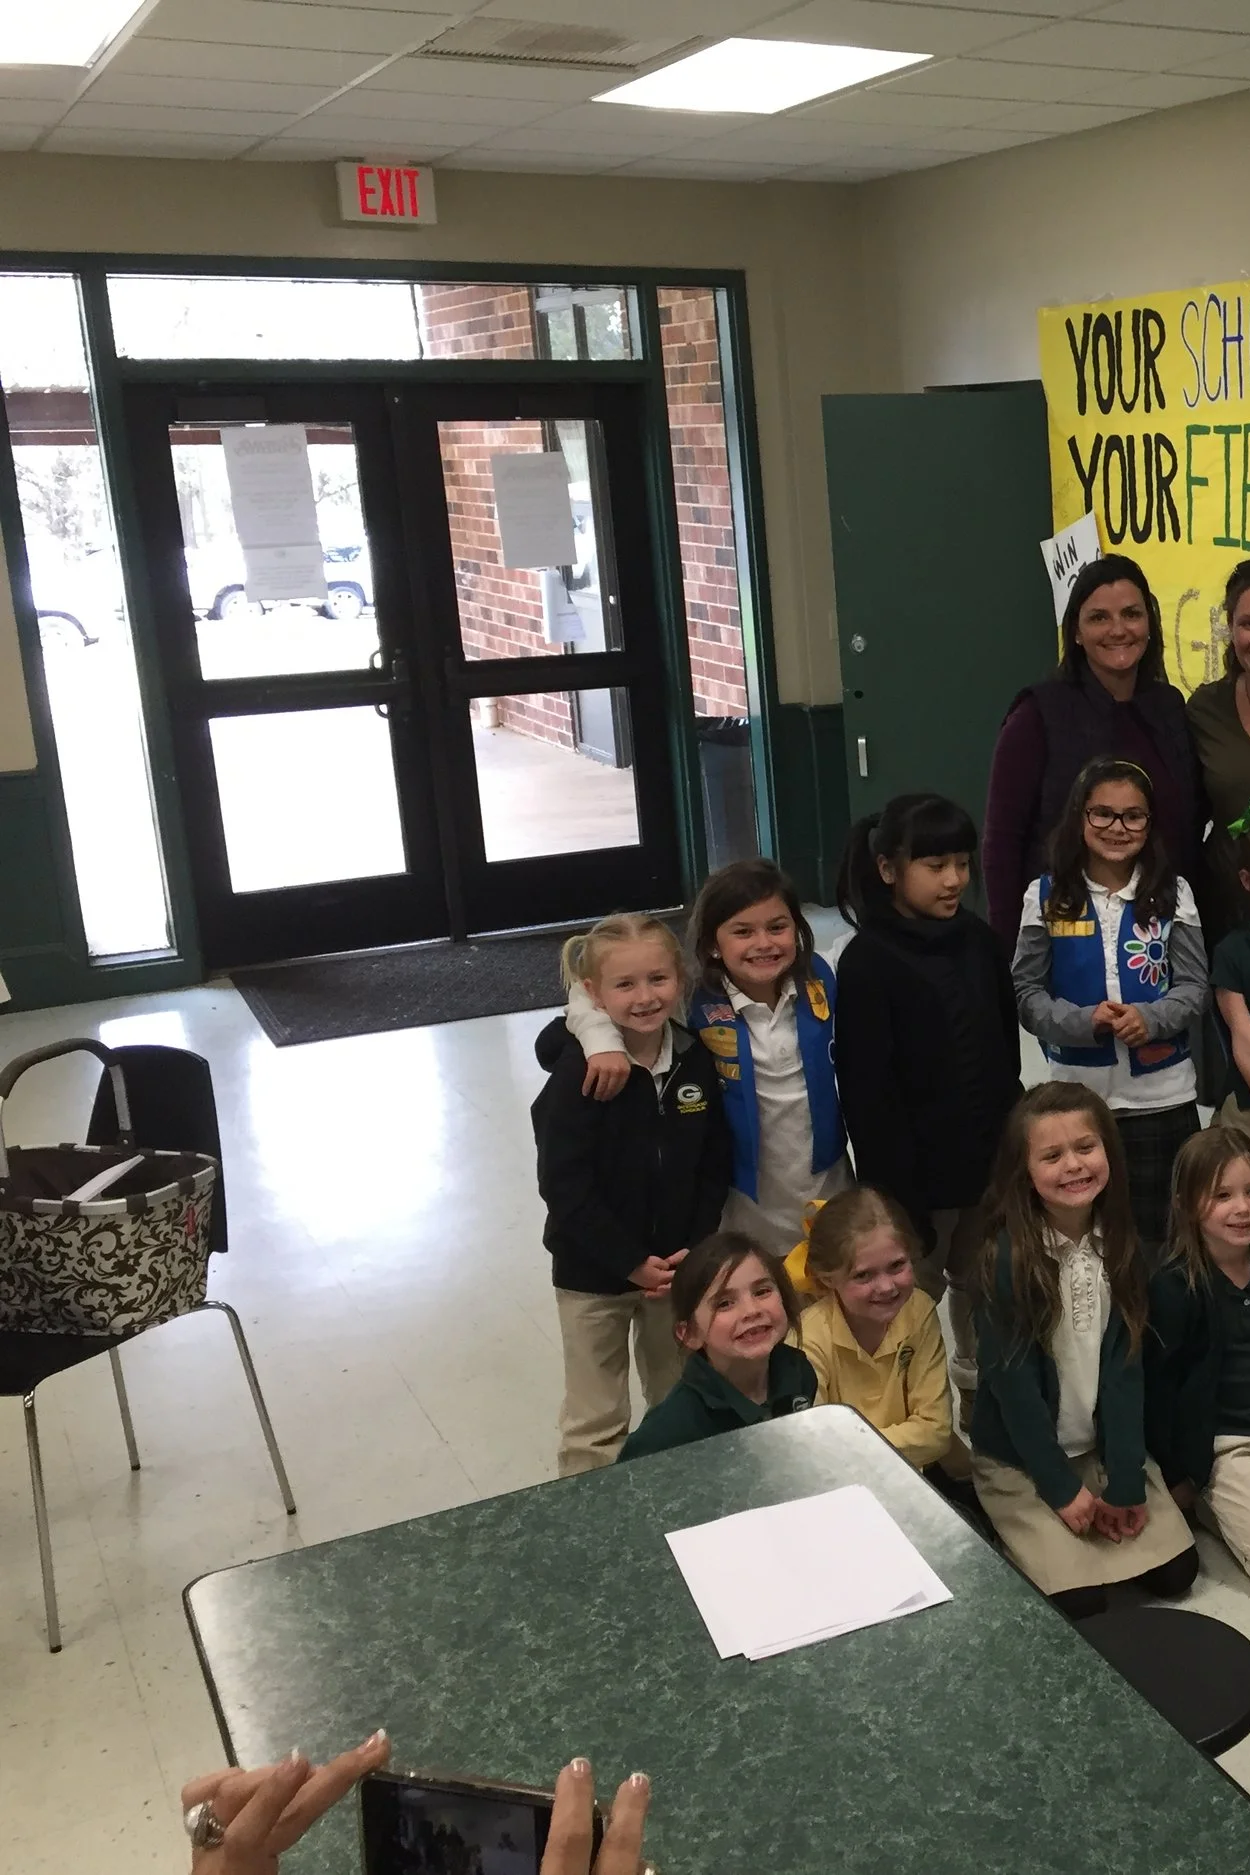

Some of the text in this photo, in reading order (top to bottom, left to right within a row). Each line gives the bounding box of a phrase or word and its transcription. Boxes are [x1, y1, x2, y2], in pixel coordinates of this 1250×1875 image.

[357, 166, 420, 218] EXIT
[1065, 307, 1166, 416] YOUR
[1067, 432, 1182, 545] YOUR
[1052, 535, 1080, 581] WIN
